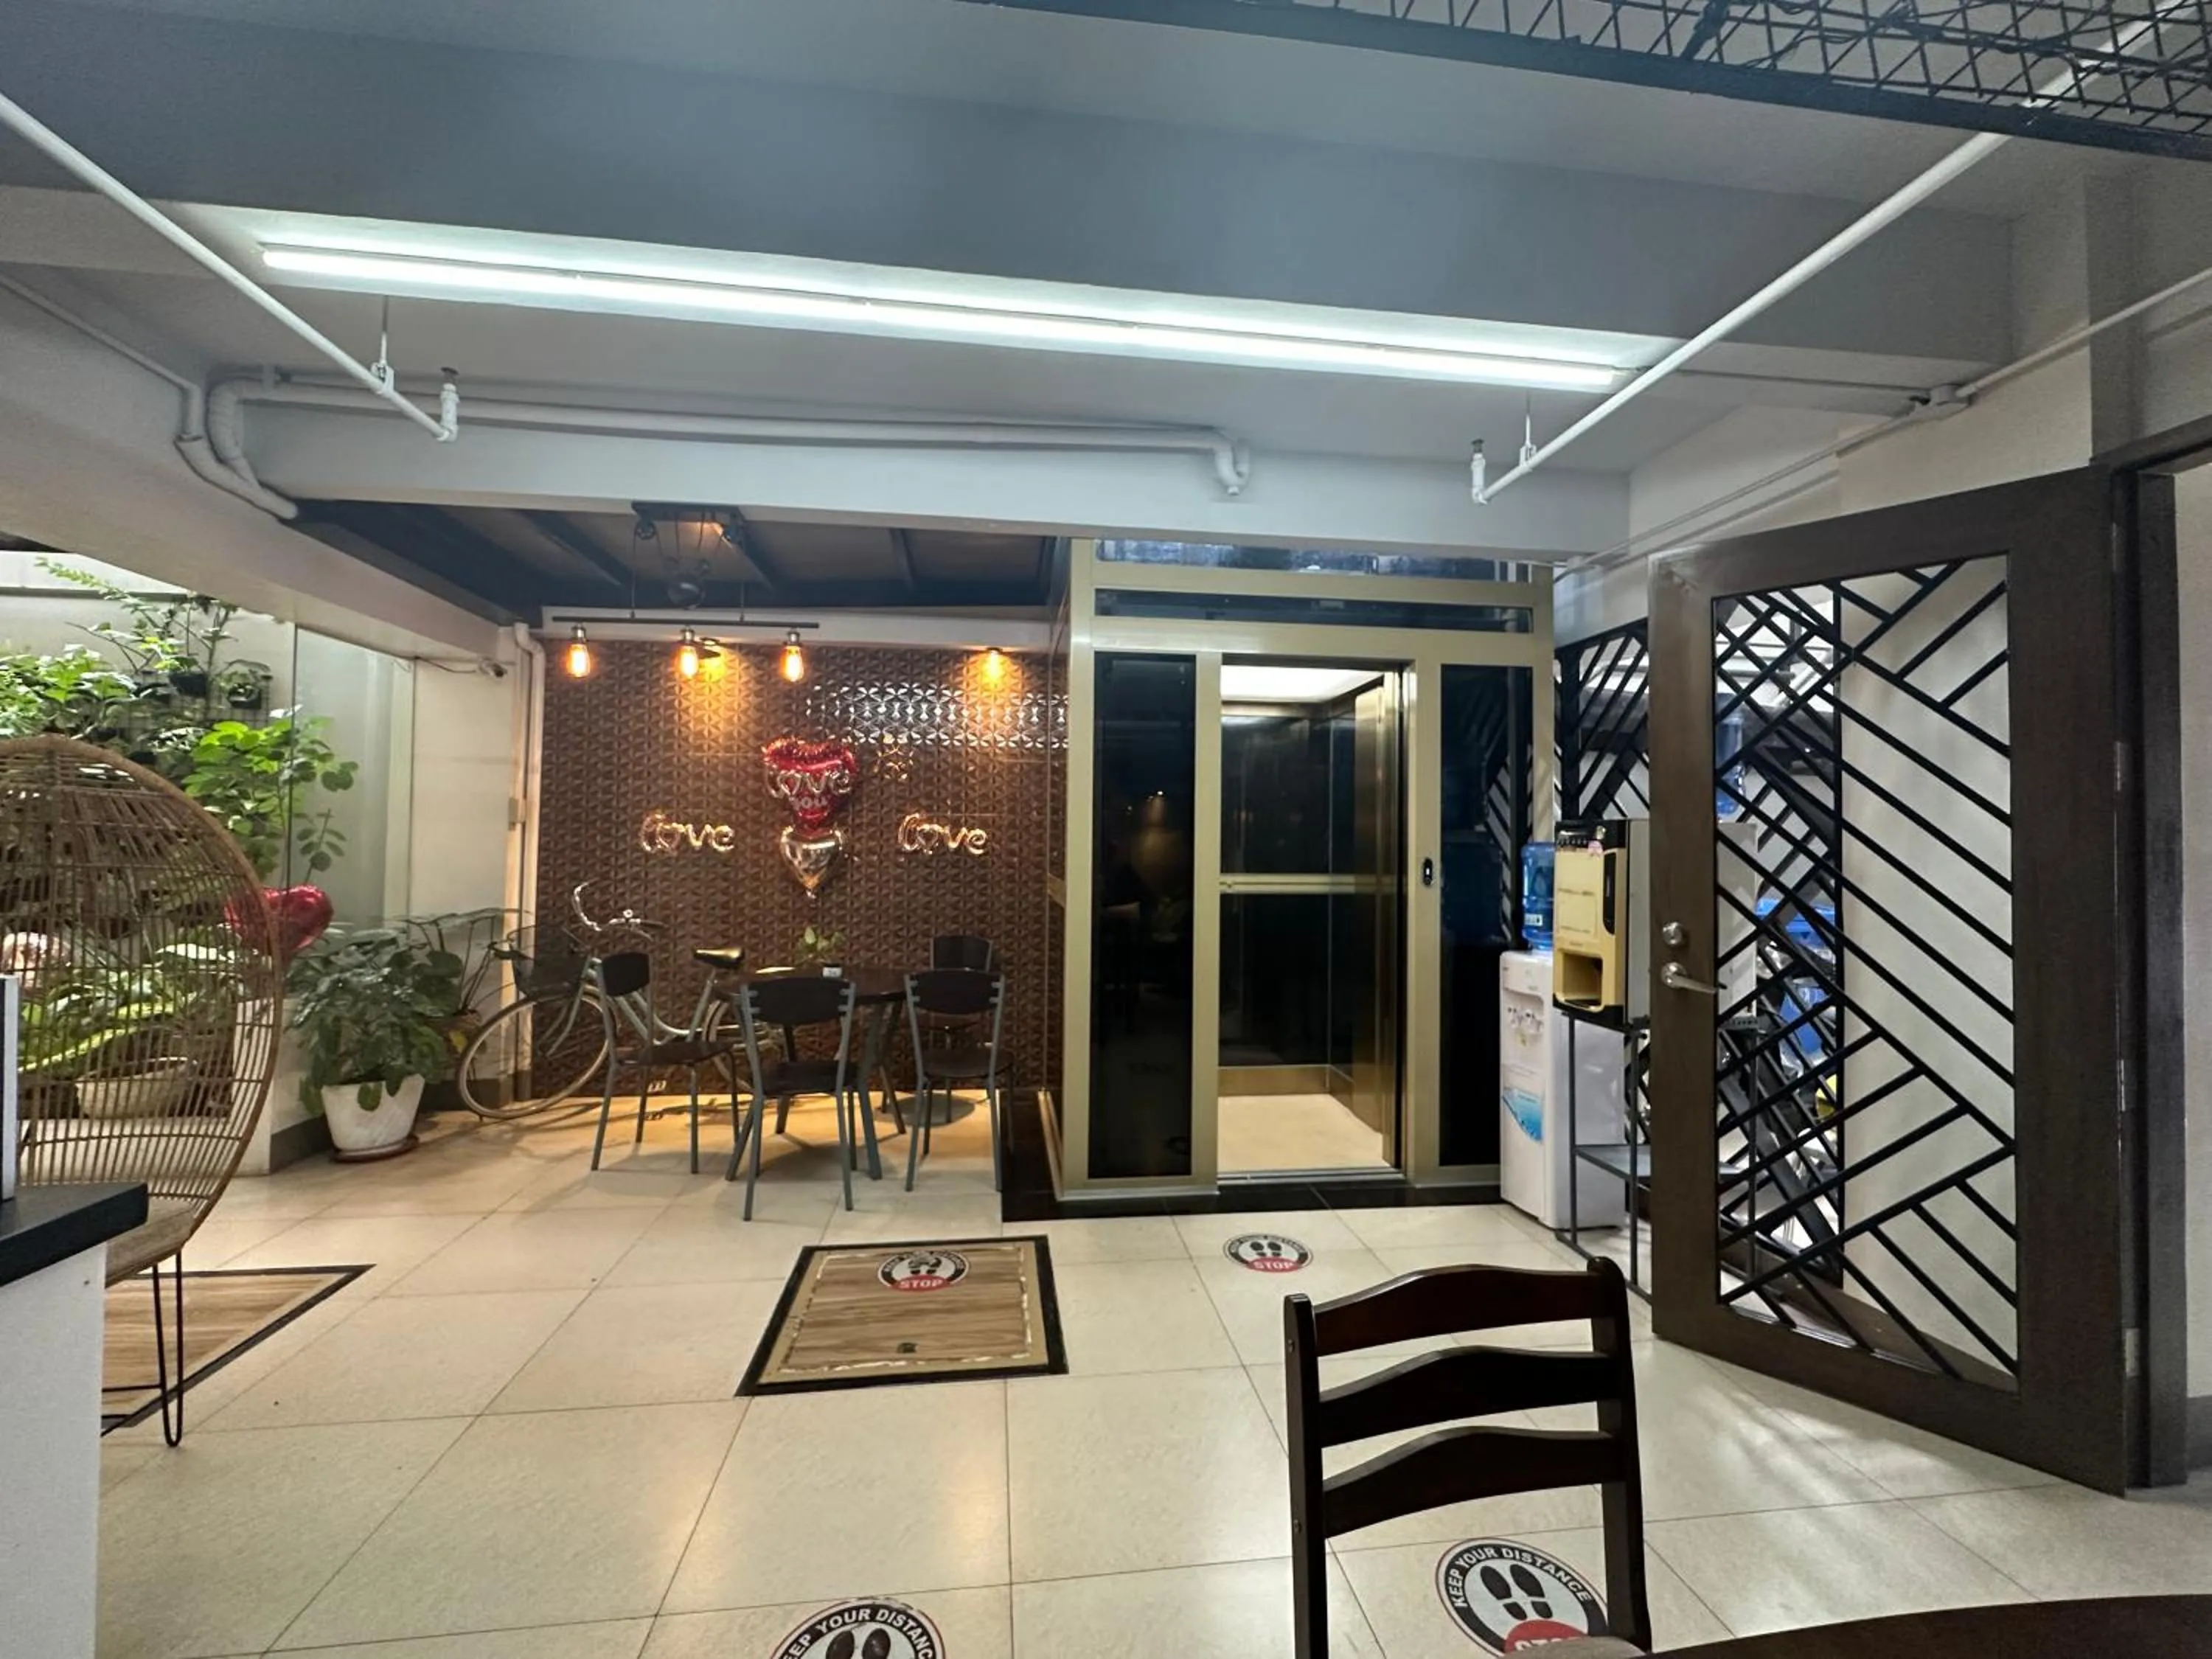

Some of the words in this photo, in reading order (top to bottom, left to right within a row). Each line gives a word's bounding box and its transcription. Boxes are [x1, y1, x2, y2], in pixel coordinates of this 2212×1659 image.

[899, 1279, 943, 1289] STOP
[1455, 1547, 1498, 1568] YOUR
[1501, 1548, 1591, 1602] DISTANCE
[1448, 1568, 1468, 1607] KEEP
[815, 1608, 871, 1634] YOUR
[875, 1608, 933, 1659] DISTANC
